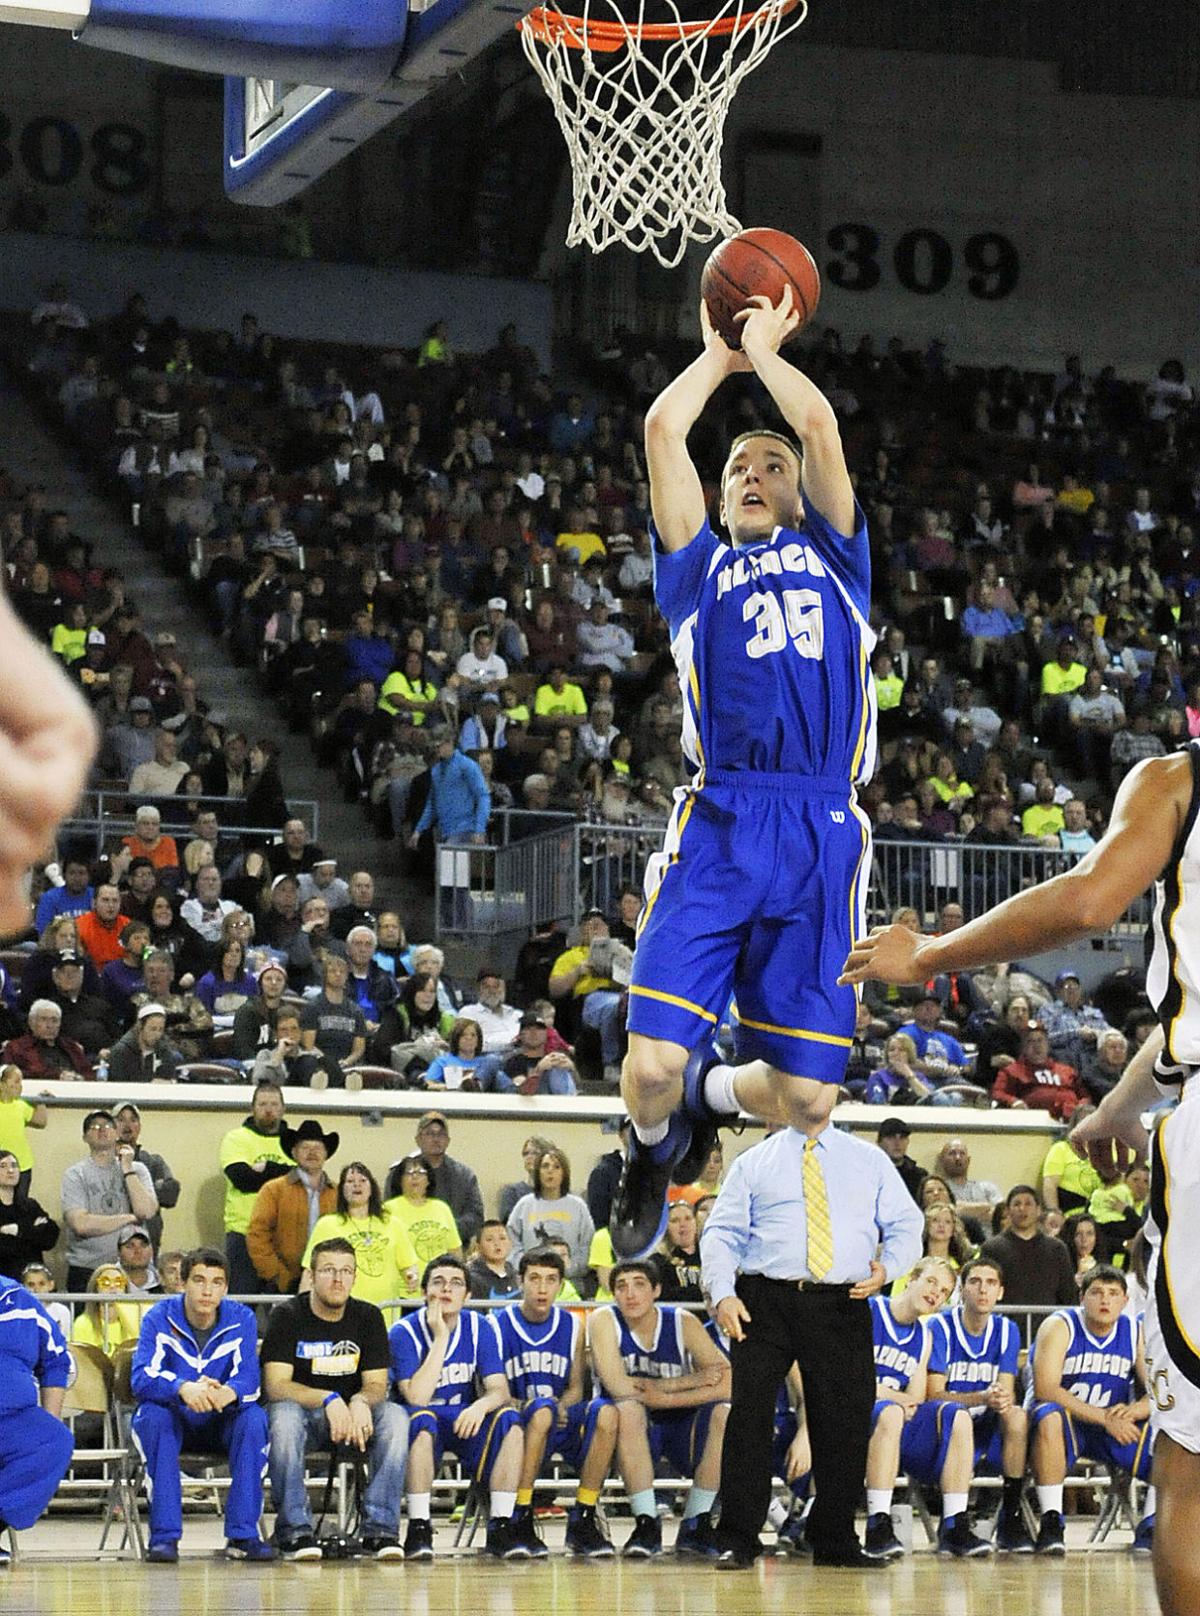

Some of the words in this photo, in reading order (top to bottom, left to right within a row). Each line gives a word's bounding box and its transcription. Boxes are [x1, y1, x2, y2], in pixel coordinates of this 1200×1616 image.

[0, 113, 148, 193] 08
[826, 222, 1021, 300] 309
[743, 588, 824, 661] 35
